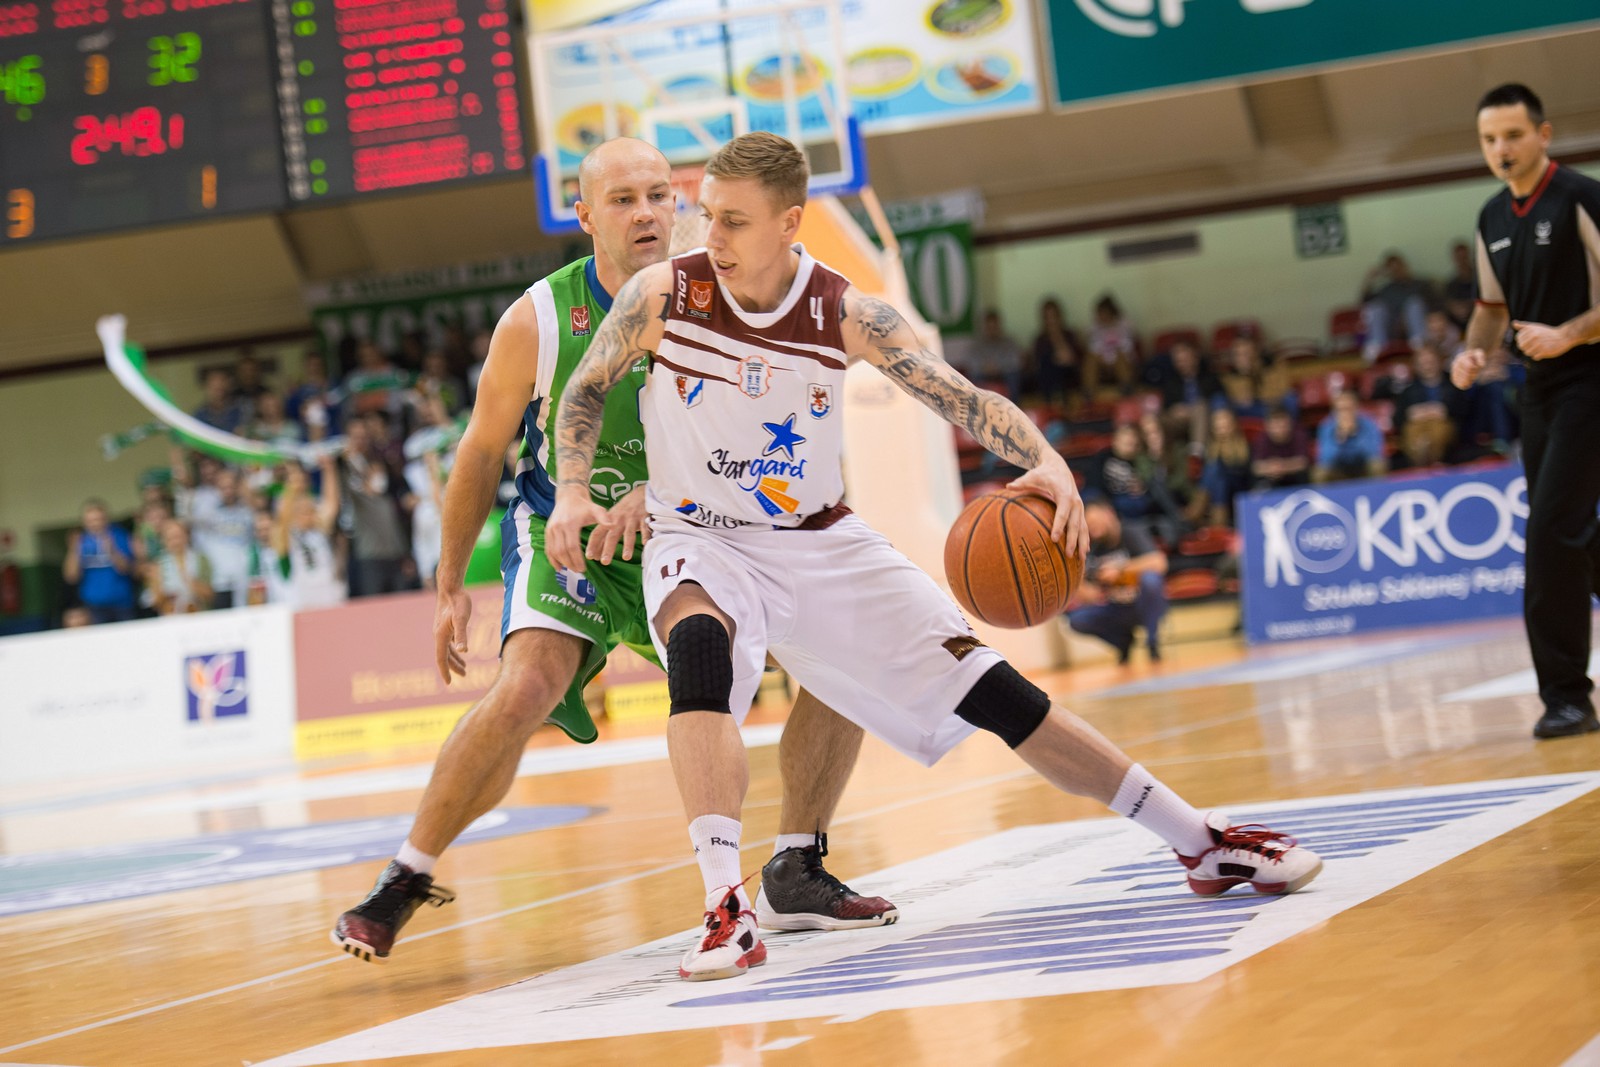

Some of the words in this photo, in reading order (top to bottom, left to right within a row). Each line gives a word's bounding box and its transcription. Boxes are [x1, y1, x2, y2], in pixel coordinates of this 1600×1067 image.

[147, 32, 201, 86] 32
[809, 297, 824, 331] 4
[707, 448, 808, 491] Stargard
